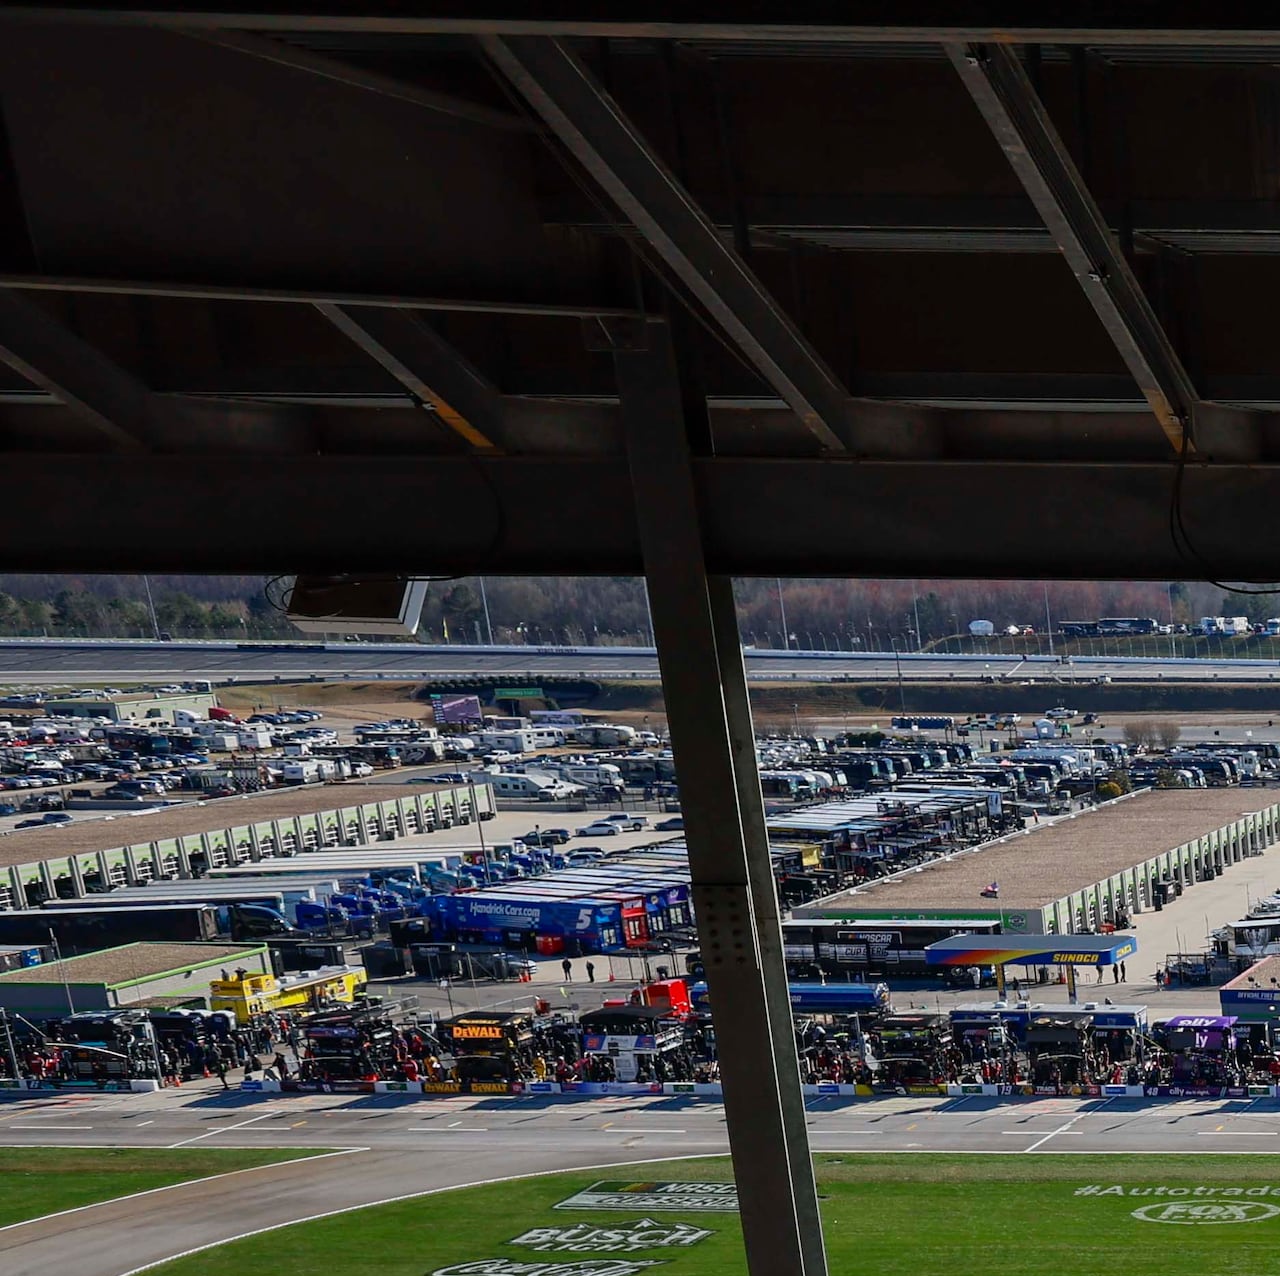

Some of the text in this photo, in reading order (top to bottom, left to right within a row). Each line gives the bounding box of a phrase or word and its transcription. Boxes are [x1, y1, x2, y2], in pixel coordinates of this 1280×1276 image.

[575, 908, 593, 930] 5
[1052, 953, 1099, 963] SUNOCO
[1177, 1017, 1217, 1027] ally
[1161, 1205, 1249, 1218] FOX
[509, 1229, 713, 1246] BUSCH
[534, 1243, 647, 1253] LIGHT
